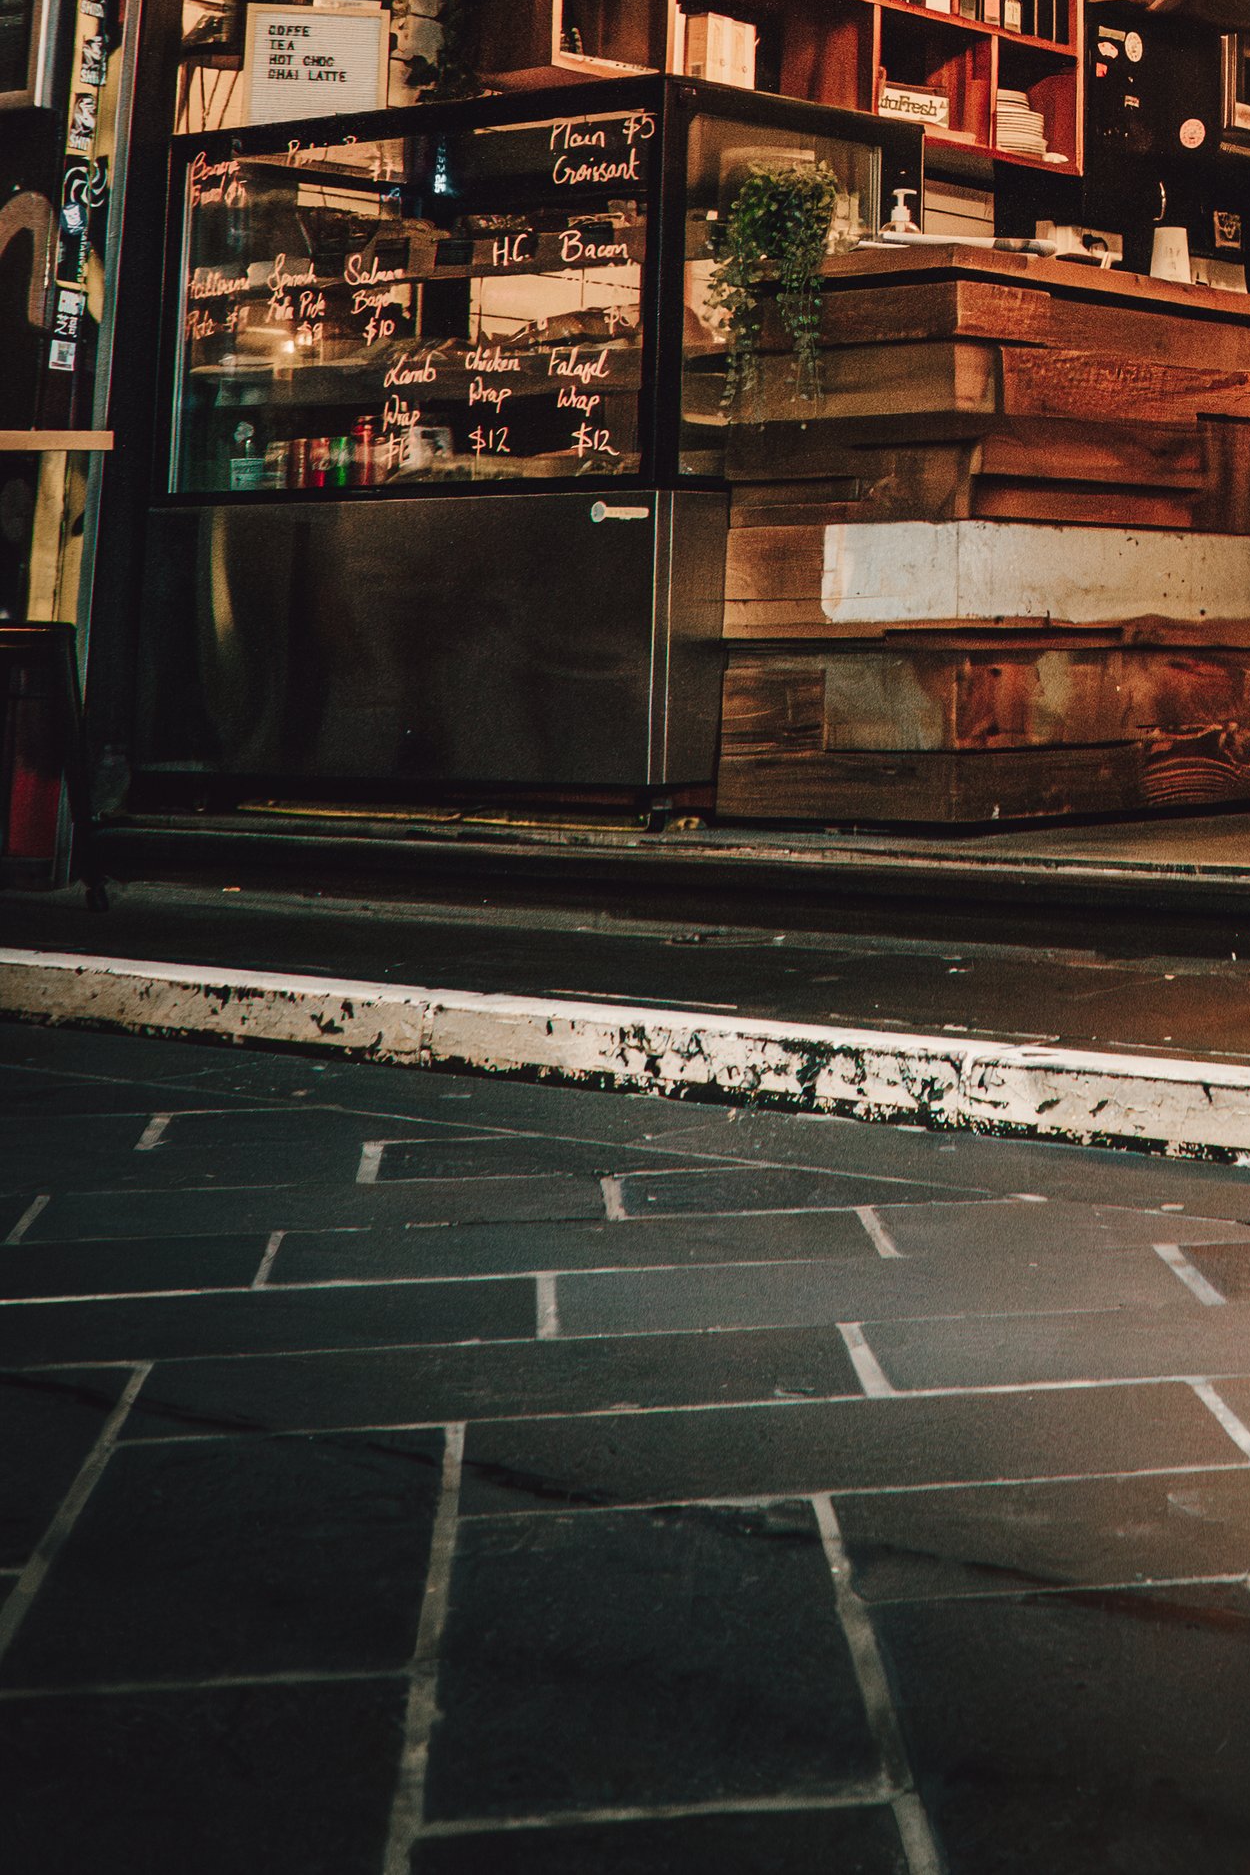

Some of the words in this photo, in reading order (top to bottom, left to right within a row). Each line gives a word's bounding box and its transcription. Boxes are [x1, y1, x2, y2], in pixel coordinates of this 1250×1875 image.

[268, 39, 295, 51] TEA
[269, 54, 295, 65] HOT
[308, 70, 347, 82] LATTE
[550, 121, 605, 151] Plain
[622, 112, 657, 145] $5
[559, 229, 630, 263] Bacon
[362, 316, 396, 347] $10
[384, 351, 438, 388] Lamb
[465, 346, 520, 374] Chicken
[469, 375, 512, 413] Wrap
[557, 385, 600, 417] Wrap
[382, 394, 420, 433] Wrap
[468, 425, 511, 457] $12
[571, 422, 620, 458] $12
